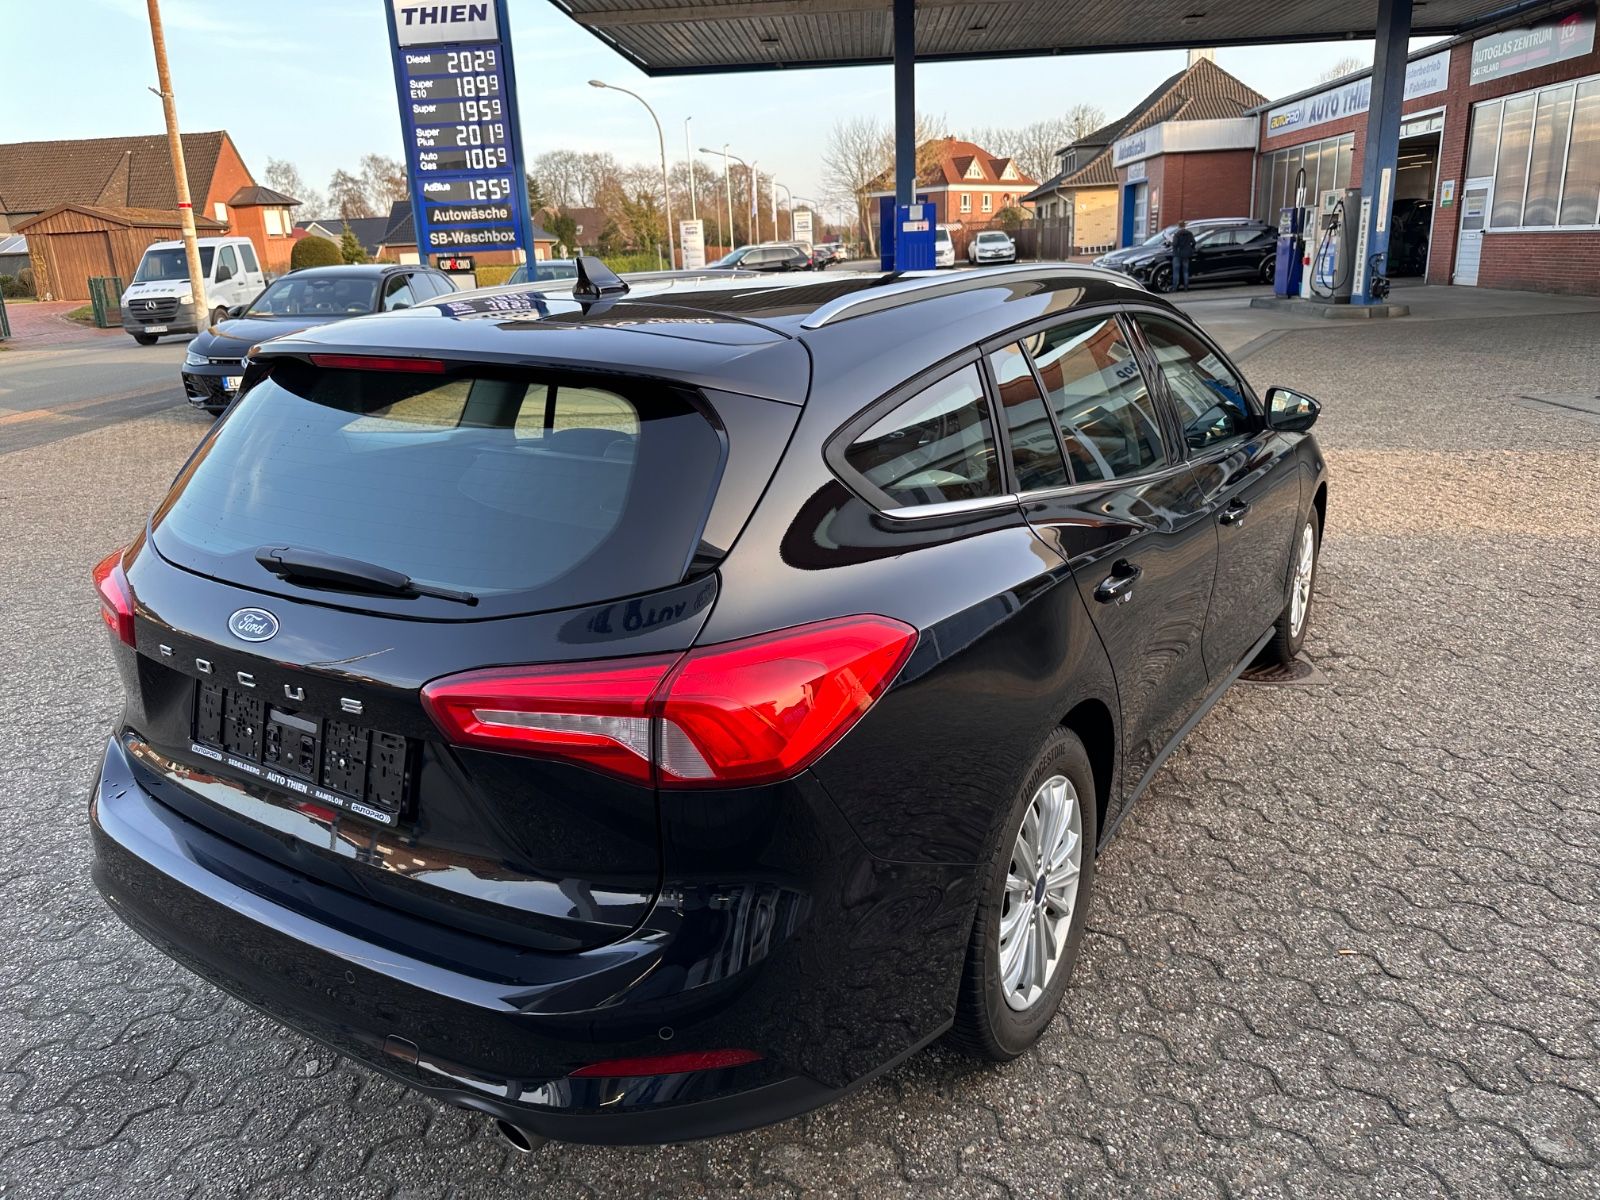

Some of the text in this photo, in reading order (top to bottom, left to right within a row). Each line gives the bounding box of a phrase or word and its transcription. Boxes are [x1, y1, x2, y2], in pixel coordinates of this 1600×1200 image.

[401, 3, 488, 25] THIEN
[1474, 27, 1552, 64] AUTOGLAS ZENTRUM
[406, 50, 496, 73] Diesel 2029
[409, 75, 498, 98] Super 1899
[411, 89, 427, 98] E10
[412, 99, 501, 121] Super 1959
[1309, 93, 1339, 123] AUTO
[1343, 80, 1371, 114] THIE
[416, 124, 504, 146] Super 2019
[417, 138, 435, 147] Plus
[420, 147, 507, 169] Auto 1069
[420, 161, 437, 170] Gas
[424, 178, 510, 200] AdBlue 1259
[432, 206, 508, 221] Autowäsche
[429, 231, 516, 246] SB-Waschbox
[237, 611, 267, 637] Ford
[158, 643, 364, 715] FOCUS
[266, 772, 286, 786] AUTO
[286, 778, 308, 795] THIEN
